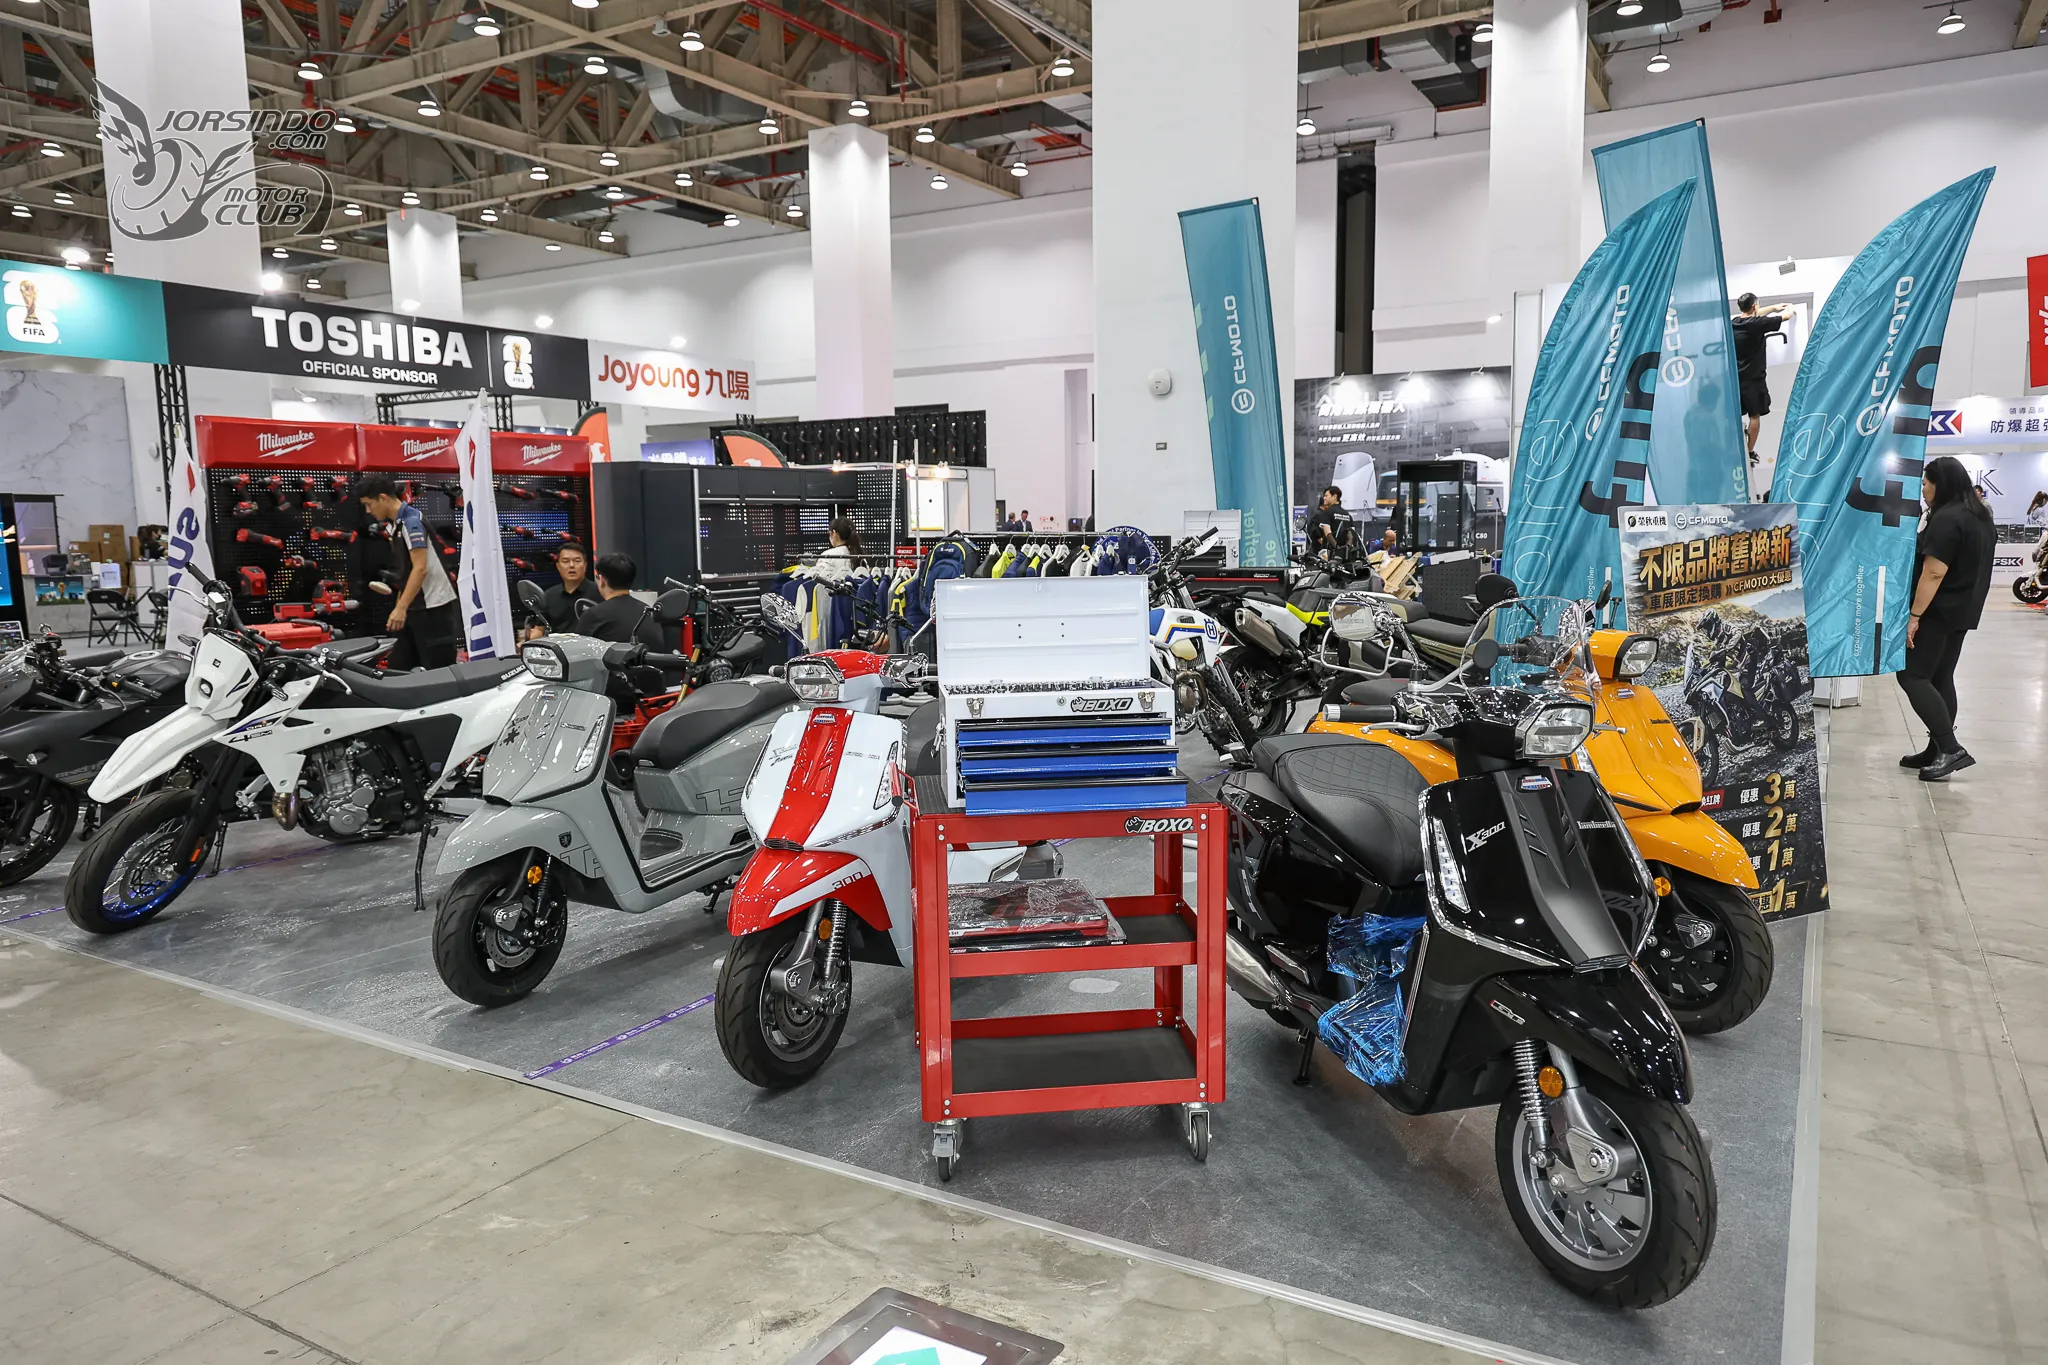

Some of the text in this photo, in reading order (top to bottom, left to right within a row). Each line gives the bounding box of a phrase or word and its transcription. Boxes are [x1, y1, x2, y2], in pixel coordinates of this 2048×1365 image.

[22, 326, 46, 337] FIFA
[251, 305, 473, 369] TOSHIBA
[302, 359, 438, 385] OFFICIAL SPONSOR
[598, 354, 700, 398] Joyoung
[705, 368, 749, 400] 九陽
[255, 430, 315, 451] Milwaukee
[401, 436, 449, 457] Milwaukee
[520, 442, 562, 461] Milwaukee
[1688, 515, 1728, 525] CFMOTO
[1475, 532, 1488, 540] C80
[1639, 524, 1793, 591] 不限品牌舊換新
[1993, 558, 2017, 566] FSK
[1587, 566, 1596, 598] together
[1650, 585, 1722, 611] 車展限定換購
[1733, 576, 1769, 593] CFMOTO
[1853, 564, 1866, 657] experience more together
[500, 664, 526, 680] SUZUKI
[1083, 697, 1133, 712] BOXO
[1740, 787, 1760, 804] 優惠
[1763, 772, 1797, 805] 3萬
[1142, 817, 1194, 833] BOXO
[1742, 805, 1798, 839] 優惠 2萬
[1466, 821, 1506, 852] X300
[1767, 839, 1795, 872] 1萬
[832, 871, 864, 890] 300
